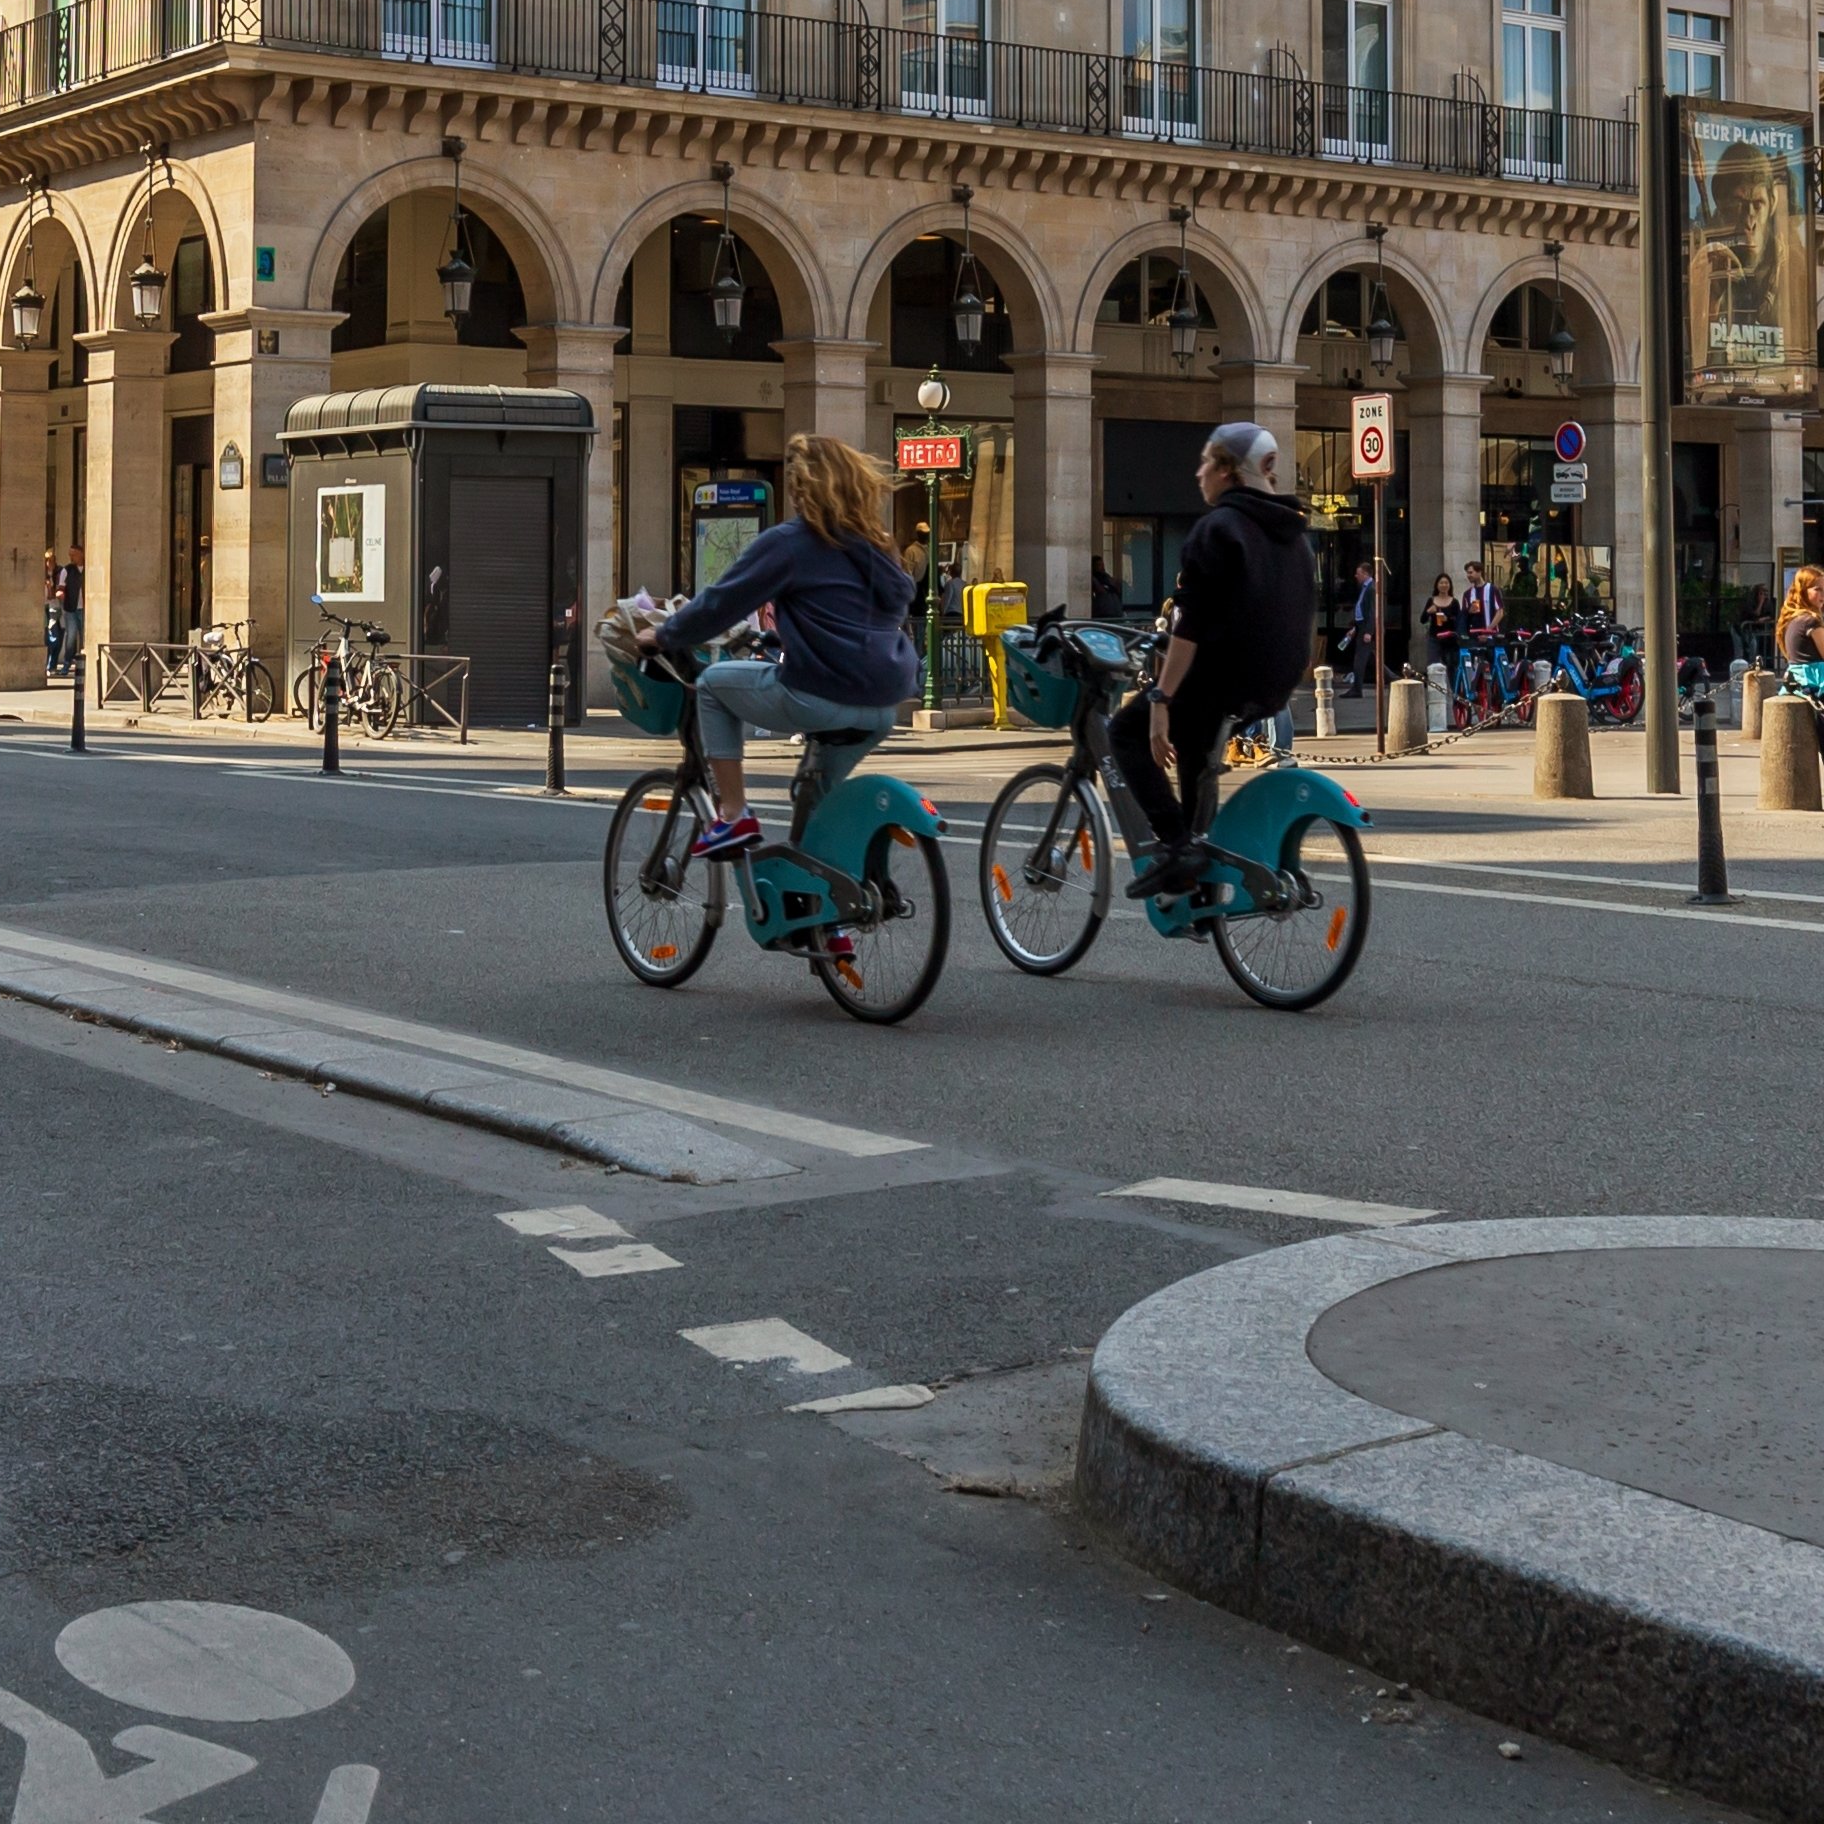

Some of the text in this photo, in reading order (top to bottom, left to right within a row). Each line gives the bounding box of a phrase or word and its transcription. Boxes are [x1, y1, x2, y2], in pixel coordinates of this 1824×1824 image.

[1694, 121, 1794, 150] LEUR PLANÈTE
[1710, 321, 1784, 346] PLANÈTE
[1360, 406, 1382, 418] ZONE
[903, 443, 957, 465] METRO
[1366, 438, 1379, 453] 30
